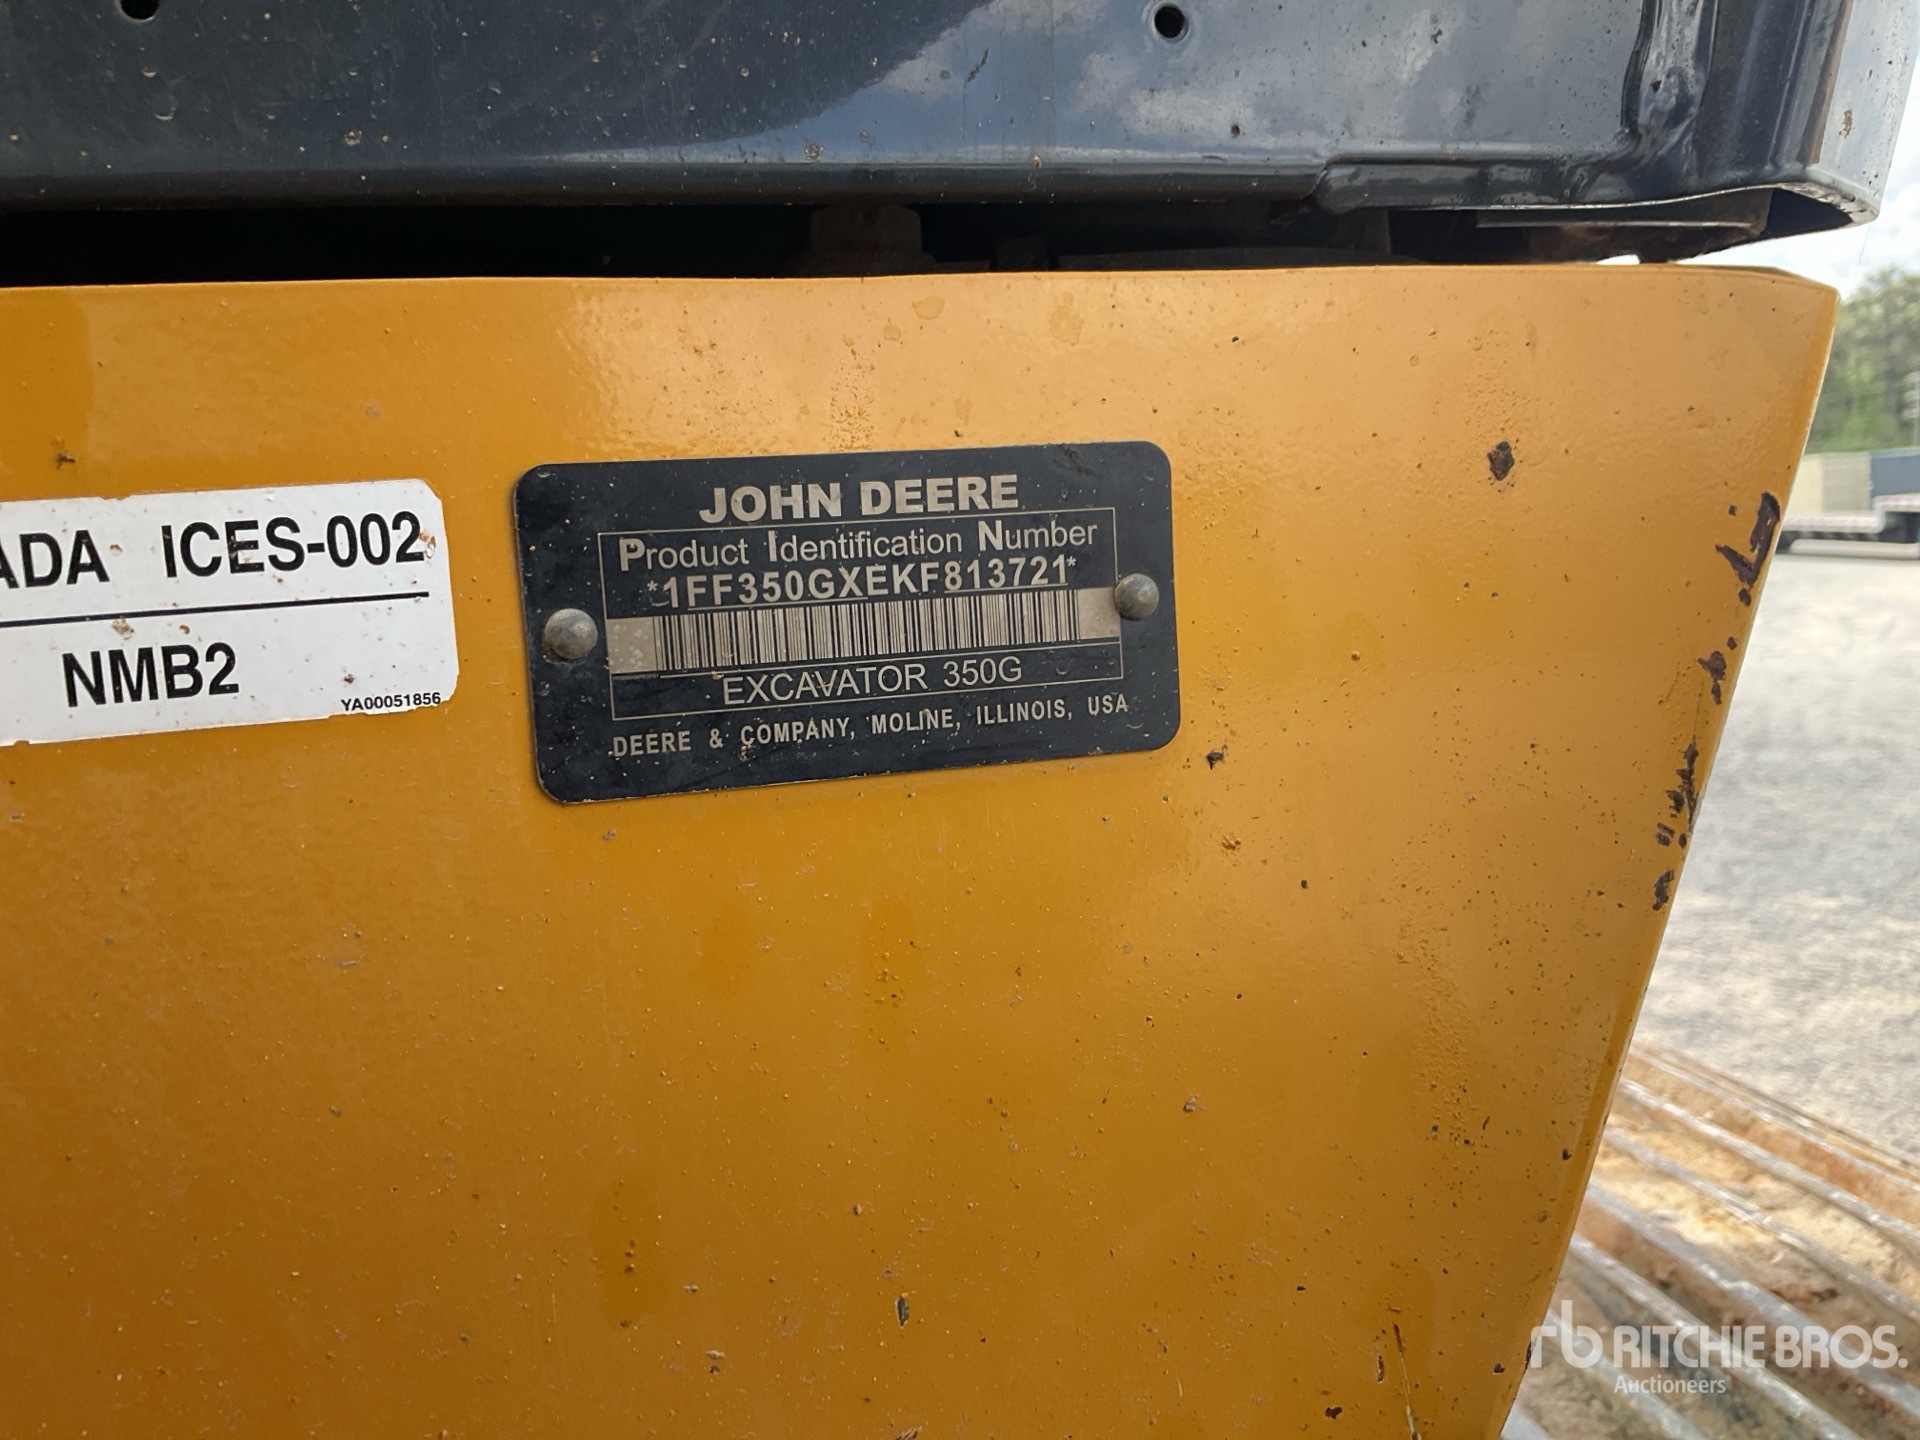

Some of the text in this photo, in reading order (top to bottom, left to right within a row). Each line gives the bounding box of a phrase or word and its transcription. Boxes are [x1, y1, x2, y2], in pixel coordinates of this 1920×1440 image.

[699, 474, 1019, 524] JOHN DEERE
[161, 511, 425, 578] ICES-002
[618, 519, 1098, 572] Product Identification Number
[61, 642, 240, 708] NMB2
[722, 655, 1023, 706] EXCAVATOR 350G
[341, 692, 442, 712] YA00051856
[612, 693, 1129, 758] DEERE & COMPANY, MOLINE, ILLINOIS, USA
